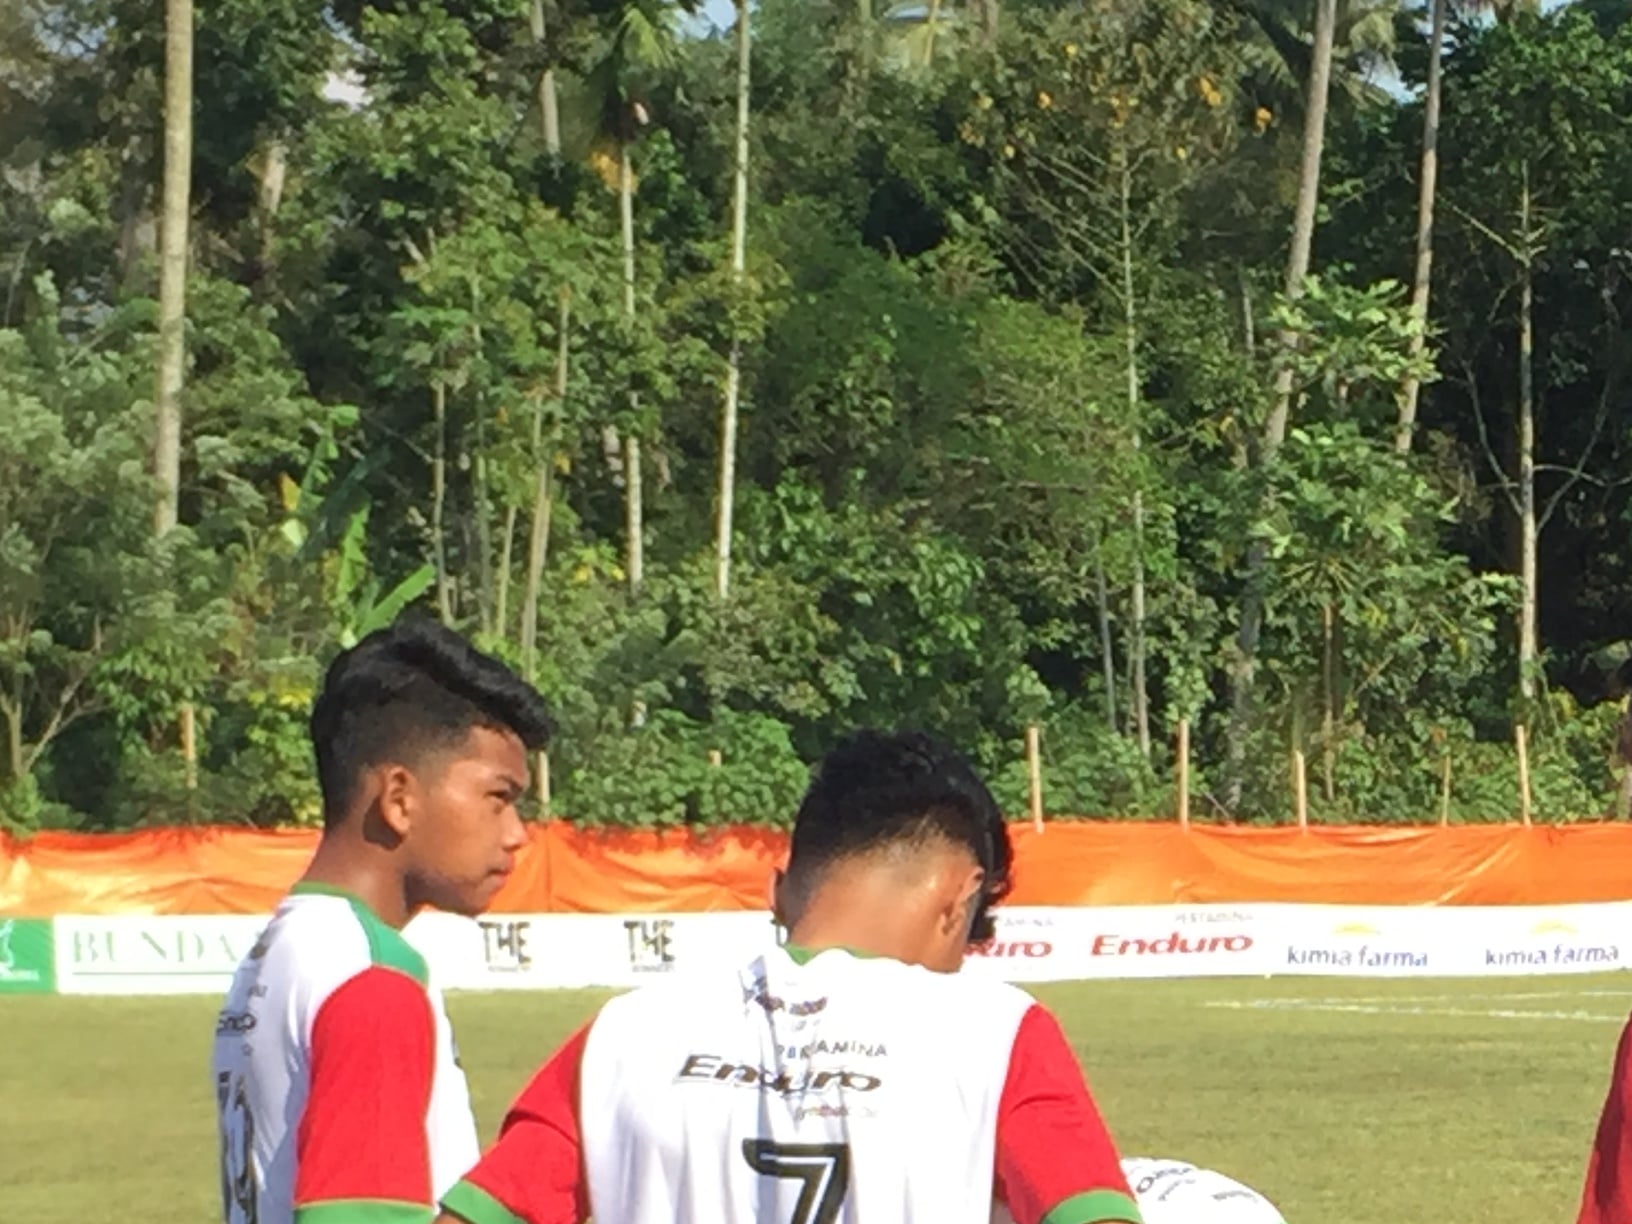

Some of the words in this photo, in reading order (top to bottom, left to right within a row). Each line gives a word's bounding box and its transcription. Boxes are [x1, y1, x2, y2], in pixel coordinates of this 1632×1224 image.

[1090, 930, 1255, 956] Enduro
[1485, 947, 1548, 966] kimia
[1553, 943, 1620, 965] farma
[1286, 945, 1352, 967] kimia
[1357, 944, 1429, 968] farma
